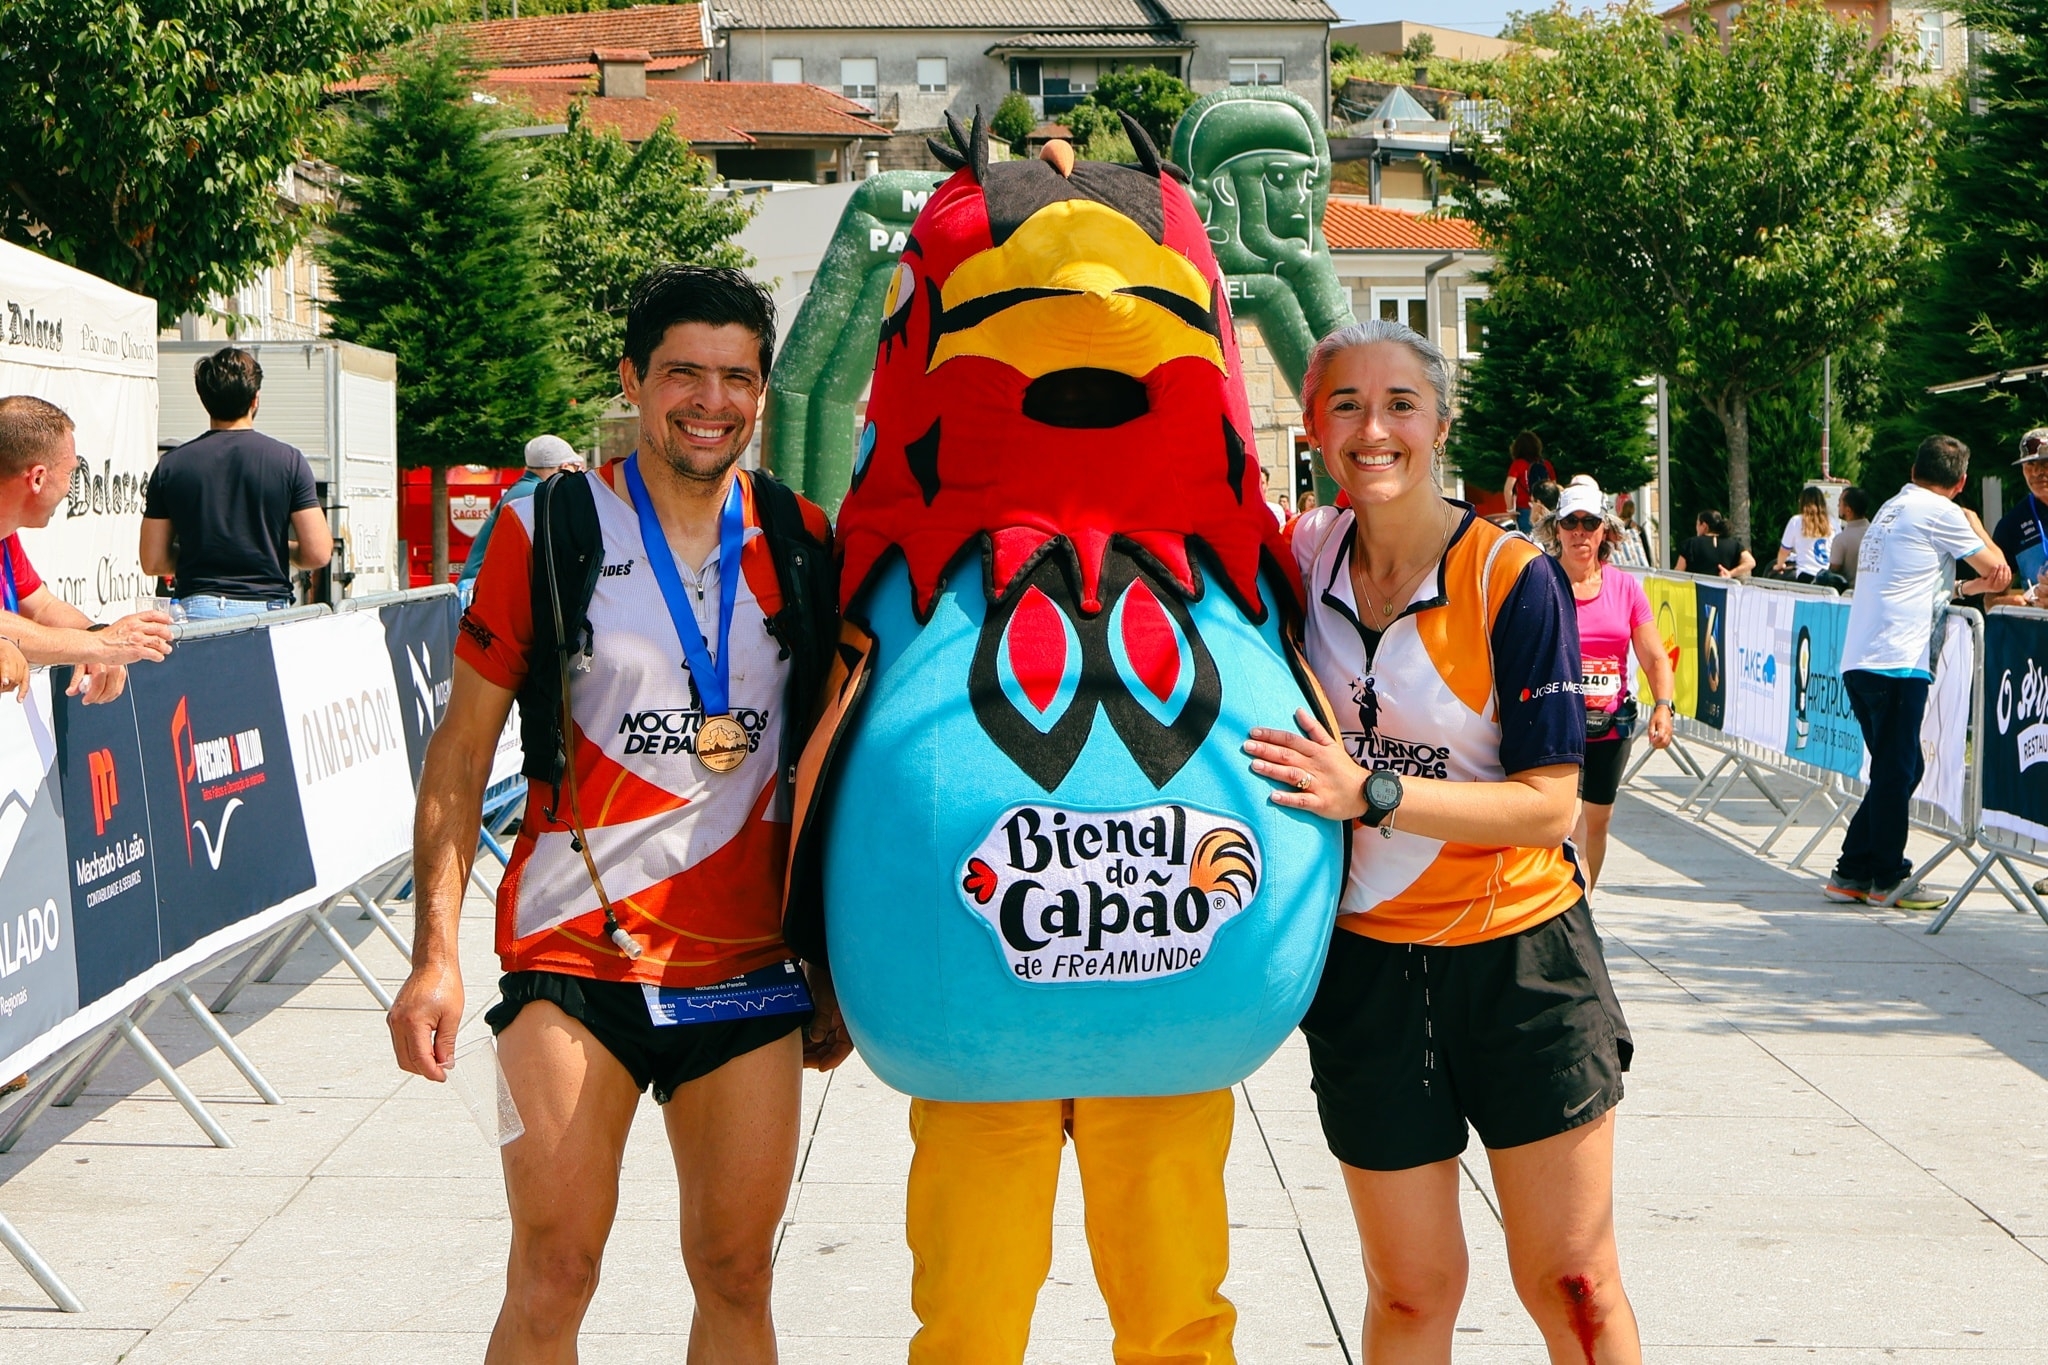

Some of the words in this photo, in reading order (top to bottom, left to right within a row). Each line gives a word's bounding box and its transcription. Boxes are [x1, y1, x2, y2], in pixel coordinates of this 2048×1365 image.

[902, 190, 936, 212] M
[7, 299, 64, 352] Dolores
[452, 508, 489, 520] SAGRES
[1807, 672, 1859, 721] ARTEXPLIC
[618, 710, 769, 734] NOCTUOS
[624, 734, 661, 755] DE
[1000, 805, 1188, 873] Bienal
[76, 846, 117, 887] Machado
[115, 841, 126, 869] &
[123, 832, 145, 864] Leão
[1106, 858, 1139, 888] do
[1014, 955, 1043, 979] de
[0, 986, 28, 1017] Regionais
